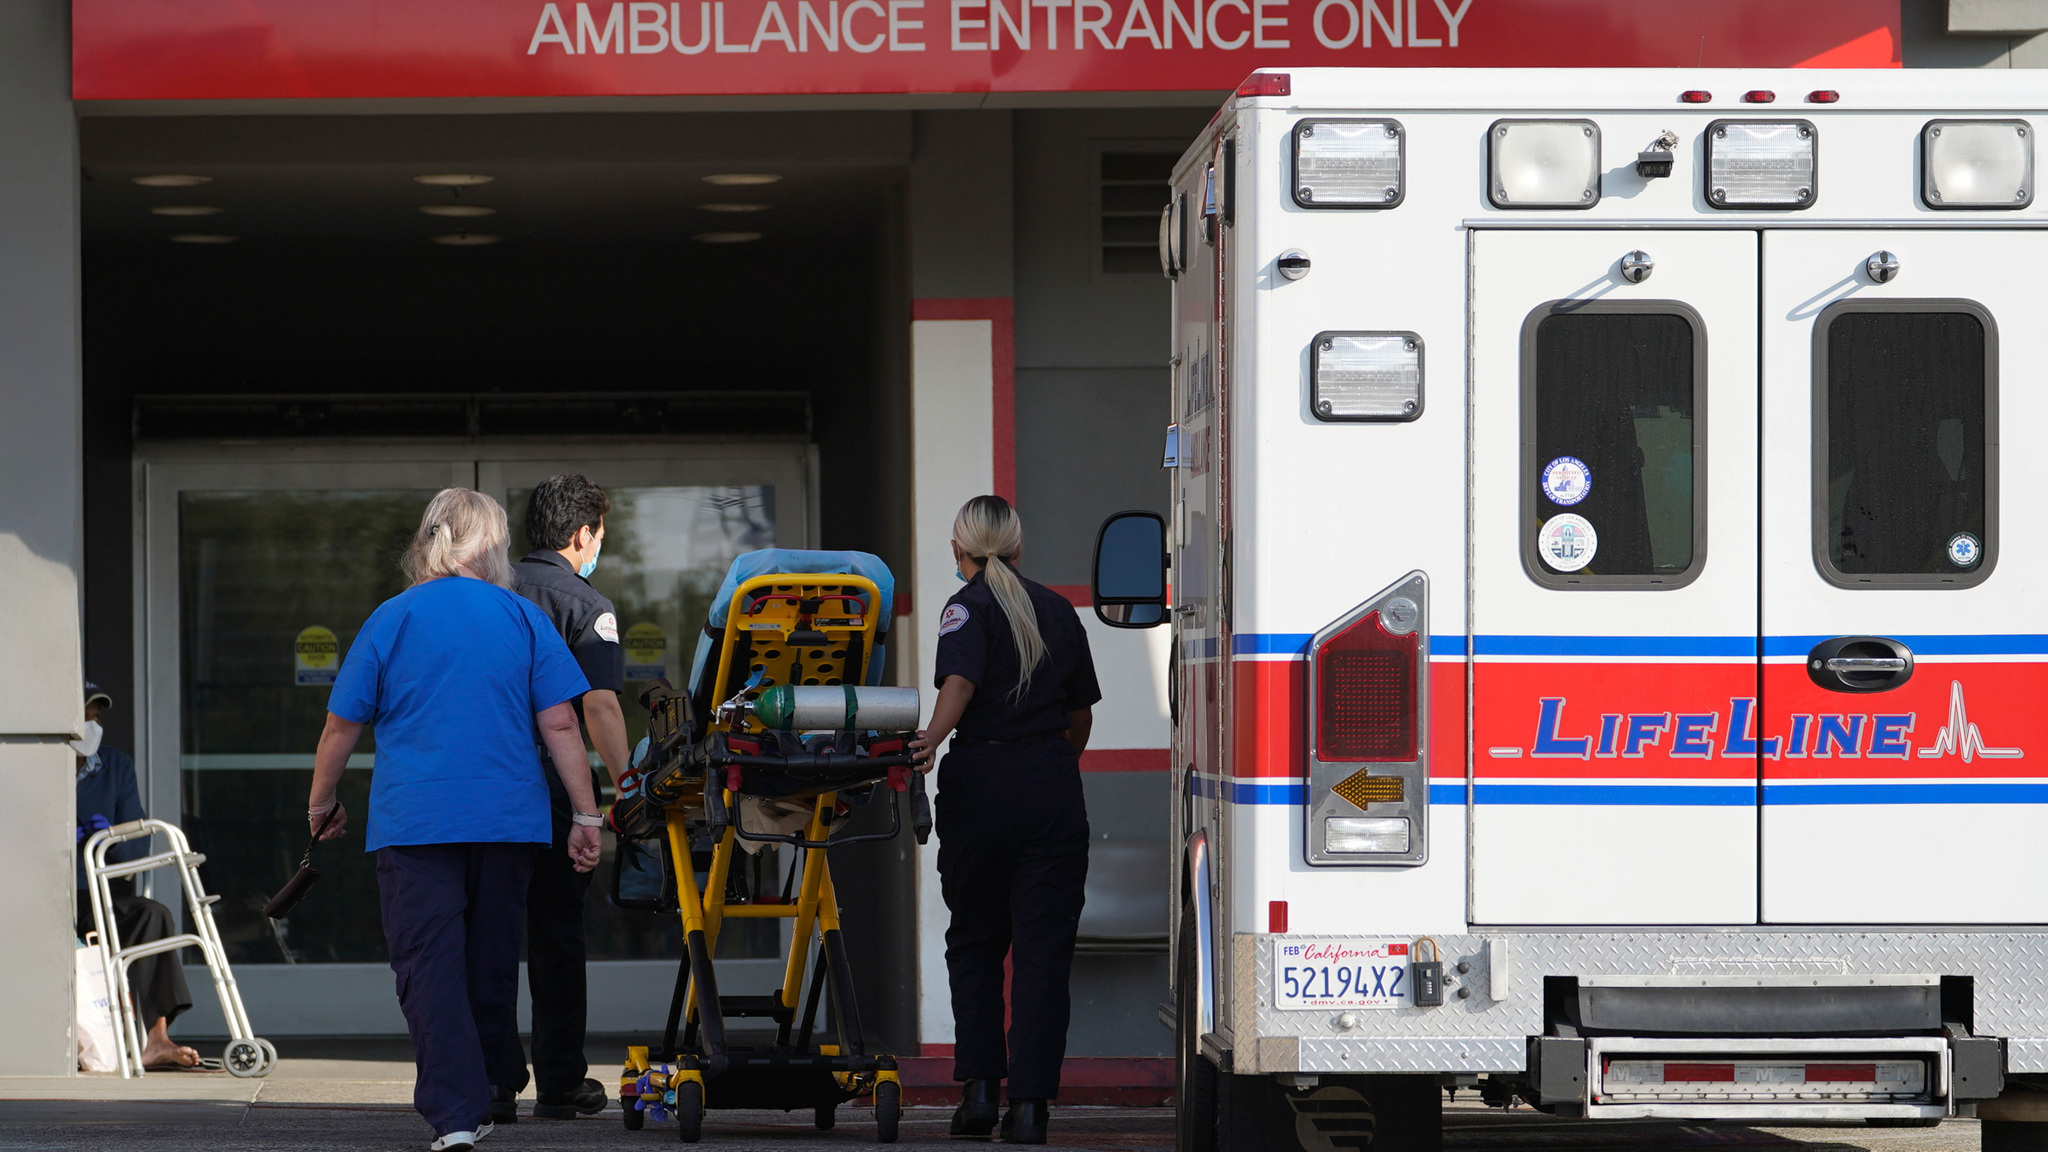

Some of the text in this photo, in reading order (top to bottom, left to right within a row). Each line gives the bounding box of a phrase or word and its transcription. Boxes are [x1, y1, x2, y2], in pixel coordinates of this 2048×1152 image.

[527, 0, 1474, 55] AMBULANCE ENTRANCE ONLY
[297, 643, 336, 652] CAUTION
[627, 639, 664, 649] CAUTION
[1283, 943, 1388, 965] FEB California
[1284, 966, 1405, 998] 52194X2
